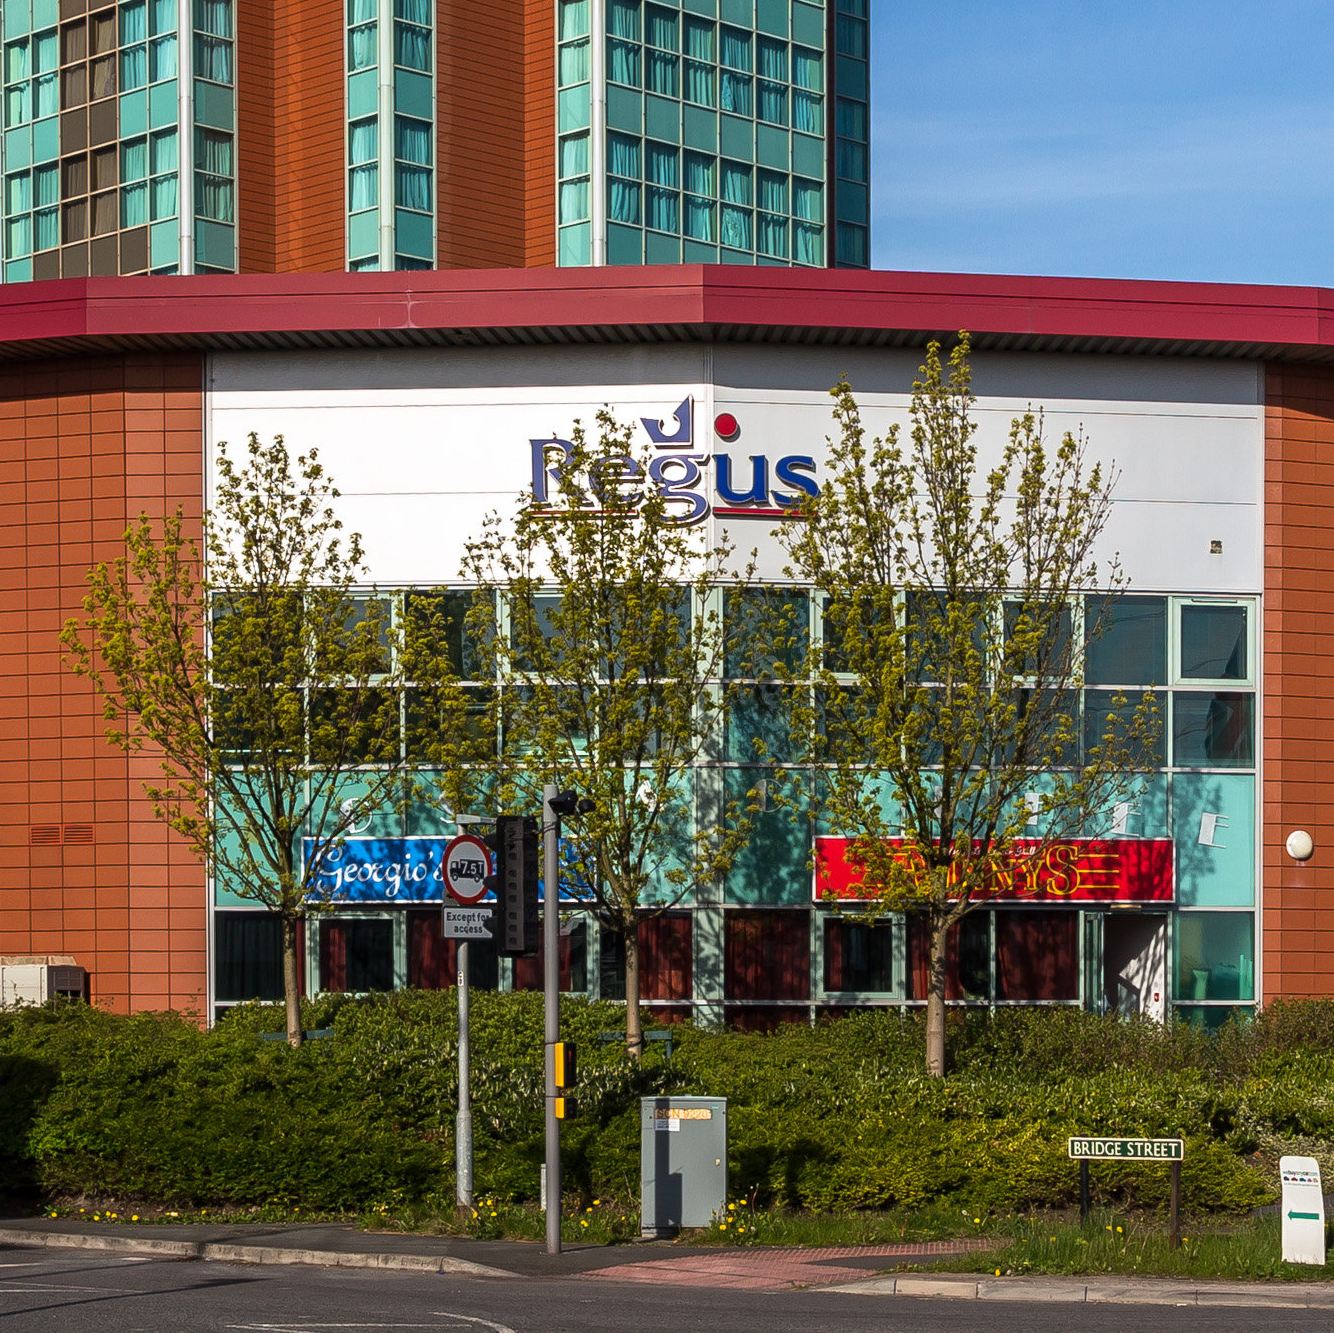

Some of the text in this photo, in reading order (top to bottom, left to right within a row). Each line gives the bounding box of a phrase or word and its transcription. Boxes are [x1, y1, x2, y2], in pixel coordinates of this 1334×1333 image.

[529, 436, 822, 524] Regus
[446, 912, 476, 925] Except
[453, 925, 483, 933] access
[1073, 1141, 1178, 1157] BRIDGE STREET
